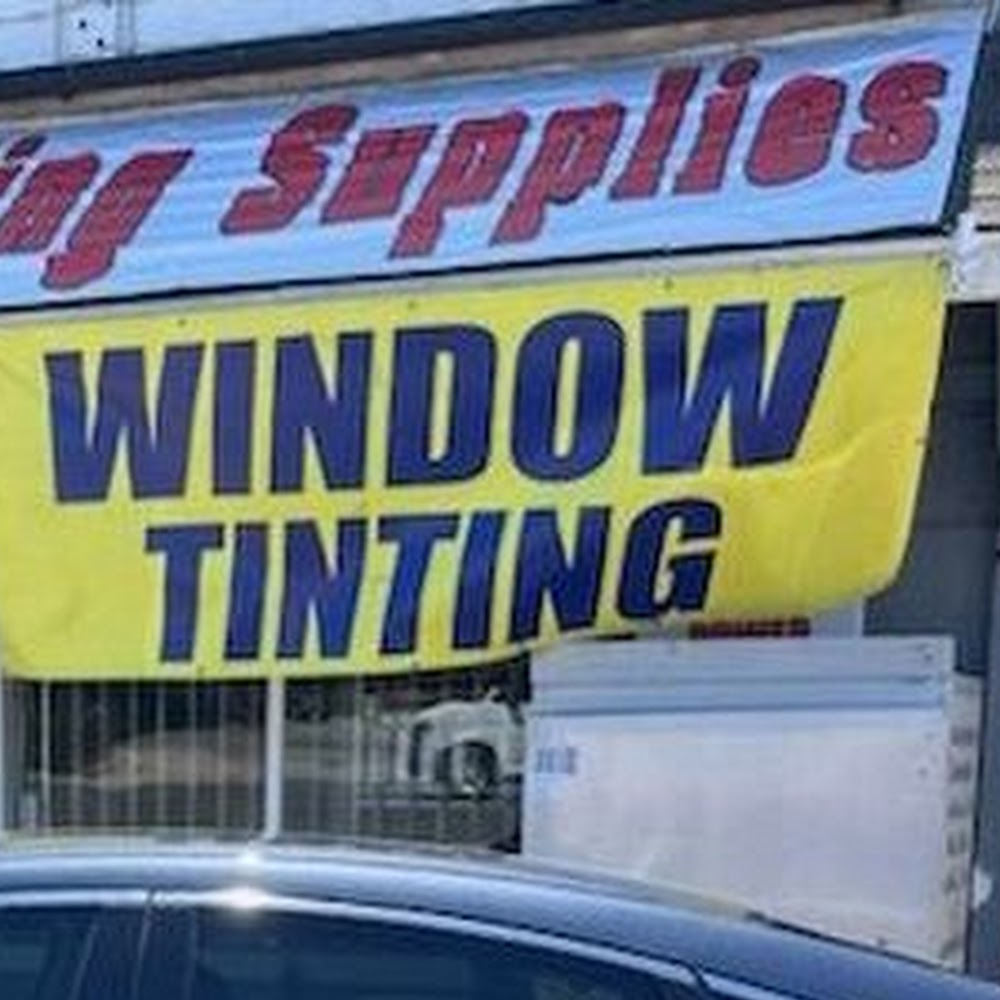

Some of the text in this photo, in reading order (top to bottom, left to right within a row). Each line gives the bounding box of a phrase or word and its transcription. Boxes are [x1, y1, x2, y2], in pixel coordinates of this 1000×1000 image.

[219, 56, 950, 260] Supplies
[44, 296, 844, 504] WINDOW
[145, 498, 723, 663] TINTING
